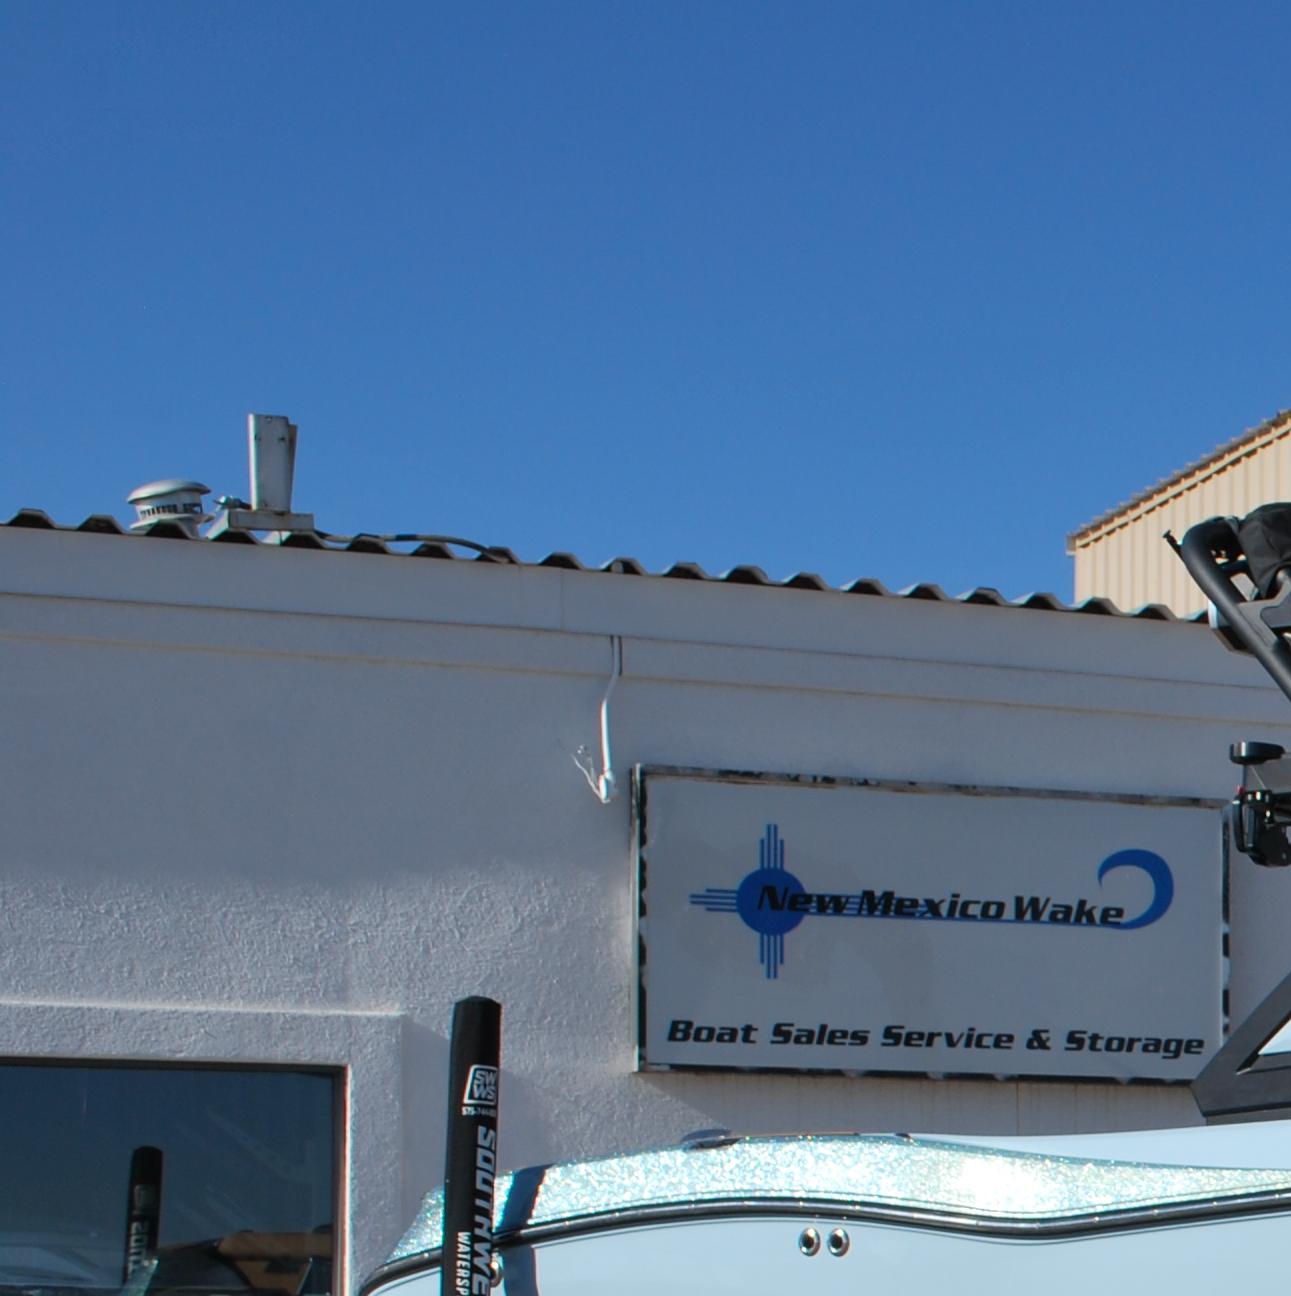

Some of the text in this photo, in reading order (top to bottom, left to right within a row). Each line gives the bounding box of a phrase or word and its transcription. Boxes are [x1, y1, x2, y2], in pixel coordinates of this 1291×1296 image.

[757, 885, 1125, 925] New Mexico Wake
[667, 1020, 1205, 1060] Boat Sales Service & Storage
